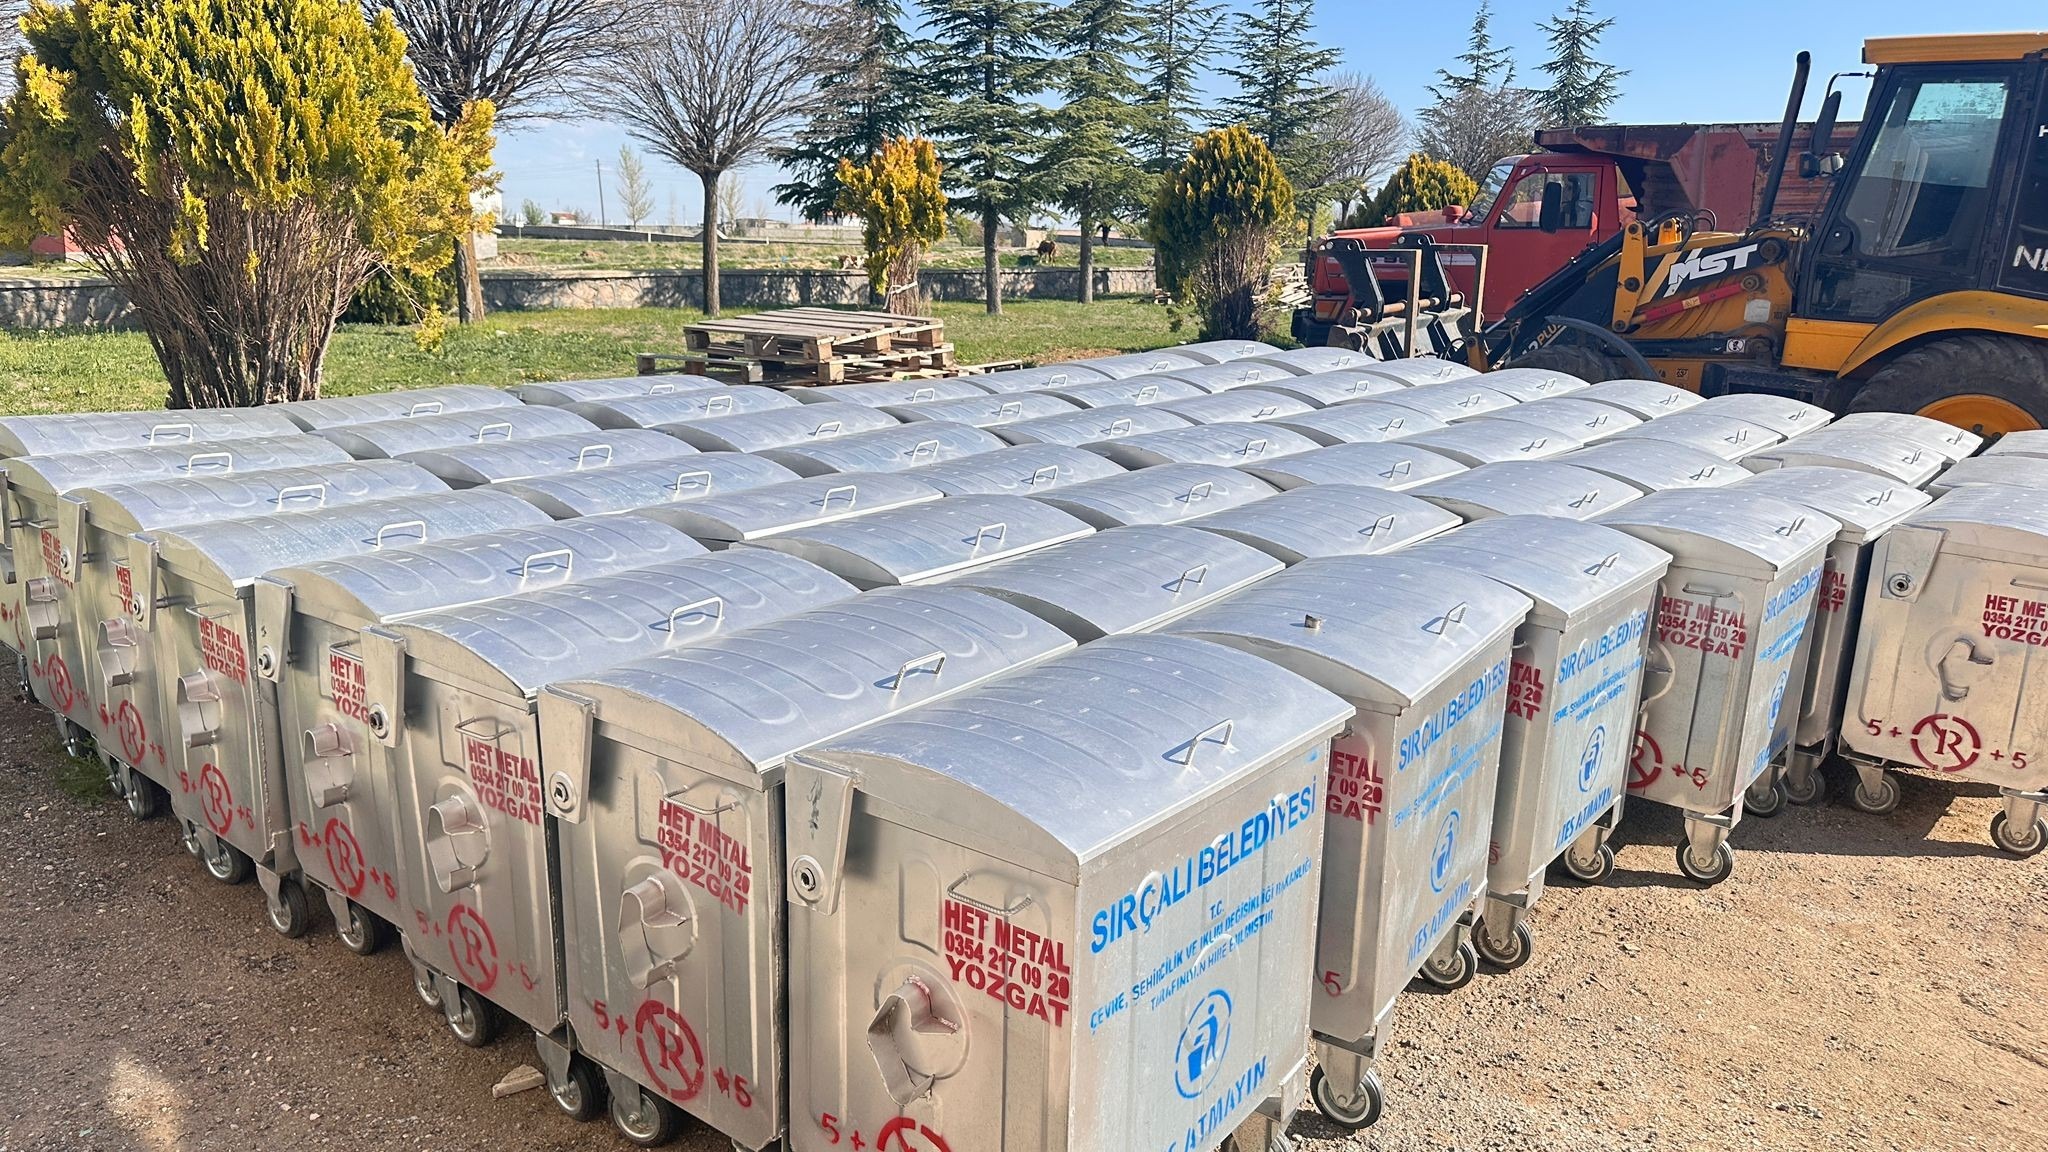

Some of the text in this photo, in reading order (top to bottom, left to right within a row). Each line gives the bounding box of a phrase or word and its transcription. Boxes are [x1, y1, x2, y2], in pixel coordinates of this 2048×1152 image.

[1663, 244, 1758, 297] MST
[1537, 324, 1562, 346] PLU
[1661, 596, 1746, 629] HET METAL
[1983, 610, 2012, 626] 0354
[2014, 615, 2038, 630] 217
[1985, 594, 2019, 613] HET
[199, 616, 244, 655] HET METAL
[1658, 614, 1746, 644] 0354 217 09 20
[1658, 627, 1744, 659] YOZGAT
[203, 651, 246, 688] YOZGAT
[330, 654, 351, 680] HET
[1512, 661, 1544, 691] TAL
[331, 676, 365, 704] 0354 217
[1523, 686, 1542, 704] 20
[332, 692, 369, 725] YOZG
[467, 737, 538, 784] HET METAL
[1332, 750, 1383, 785] ETAL
[471, 762, 541, 803] 0354 217 09 20
[1340, 778, 1358, 798] 09
[1362, 784, 1382, 804] 20
[472, 782, 542, 825] YOZGAT
[659, 799, 752, 873] HET METAL
[657, 826, 750, 894] 0354 217 09 20
[1090, 856, 1193, 954] SIRÇALI
[1197, 775, 1317, 888] BELEDİYESİ
[659, 848, 749, 918] YOZGAT
[944, 899, 1071, 976] HET METAL
[944, 930, 1071, 1000] 0354 217 09 20
[945, 953, 1070, 1028] YOZGAT
[1325, 970, 1341, 998] 5
[1184, 1055, 1267, 1152] ATMAYIN
